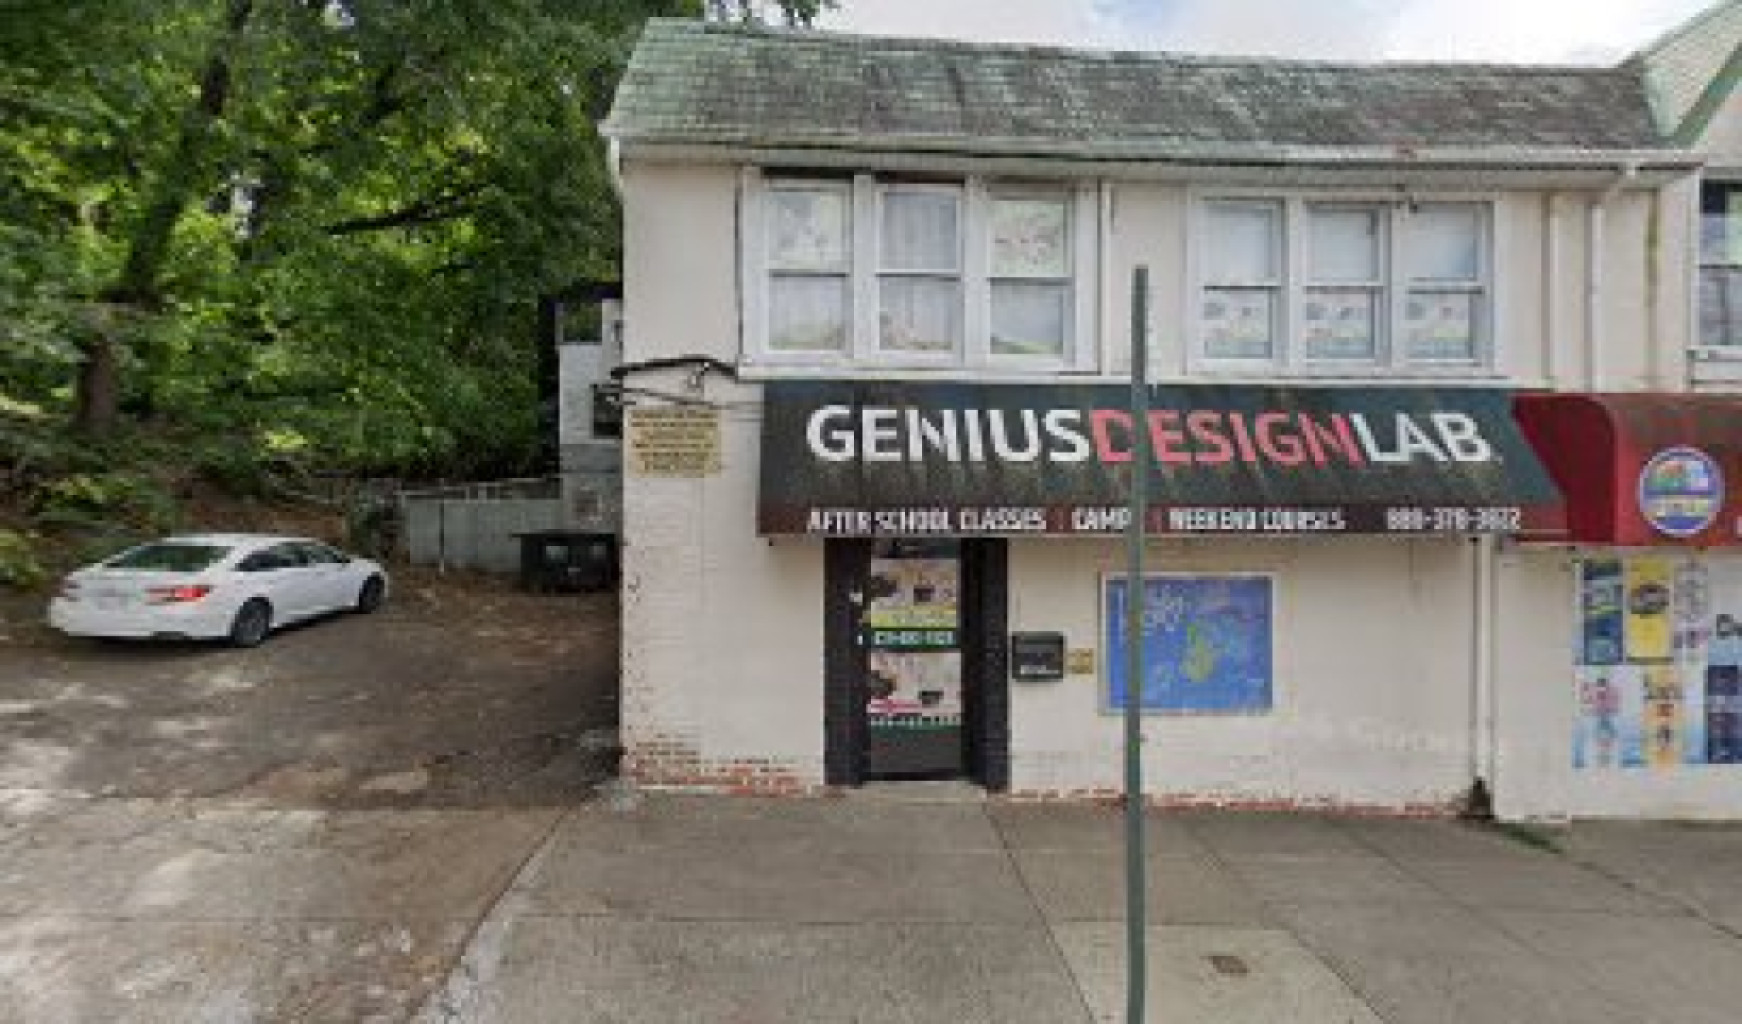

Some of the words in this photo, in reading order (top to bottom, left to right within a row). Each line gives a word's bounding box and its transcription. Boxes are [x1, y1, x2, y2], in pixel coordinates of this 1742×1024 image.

[808, 508, 870, 533] AFTER
[873, 508, 949, 533] SCHOOL
[959, 508, 1046, 531] CLASSES
[1072, 508, 1137, 532] CAMP
[1169, 507, 1256, 530] WEEKEND
